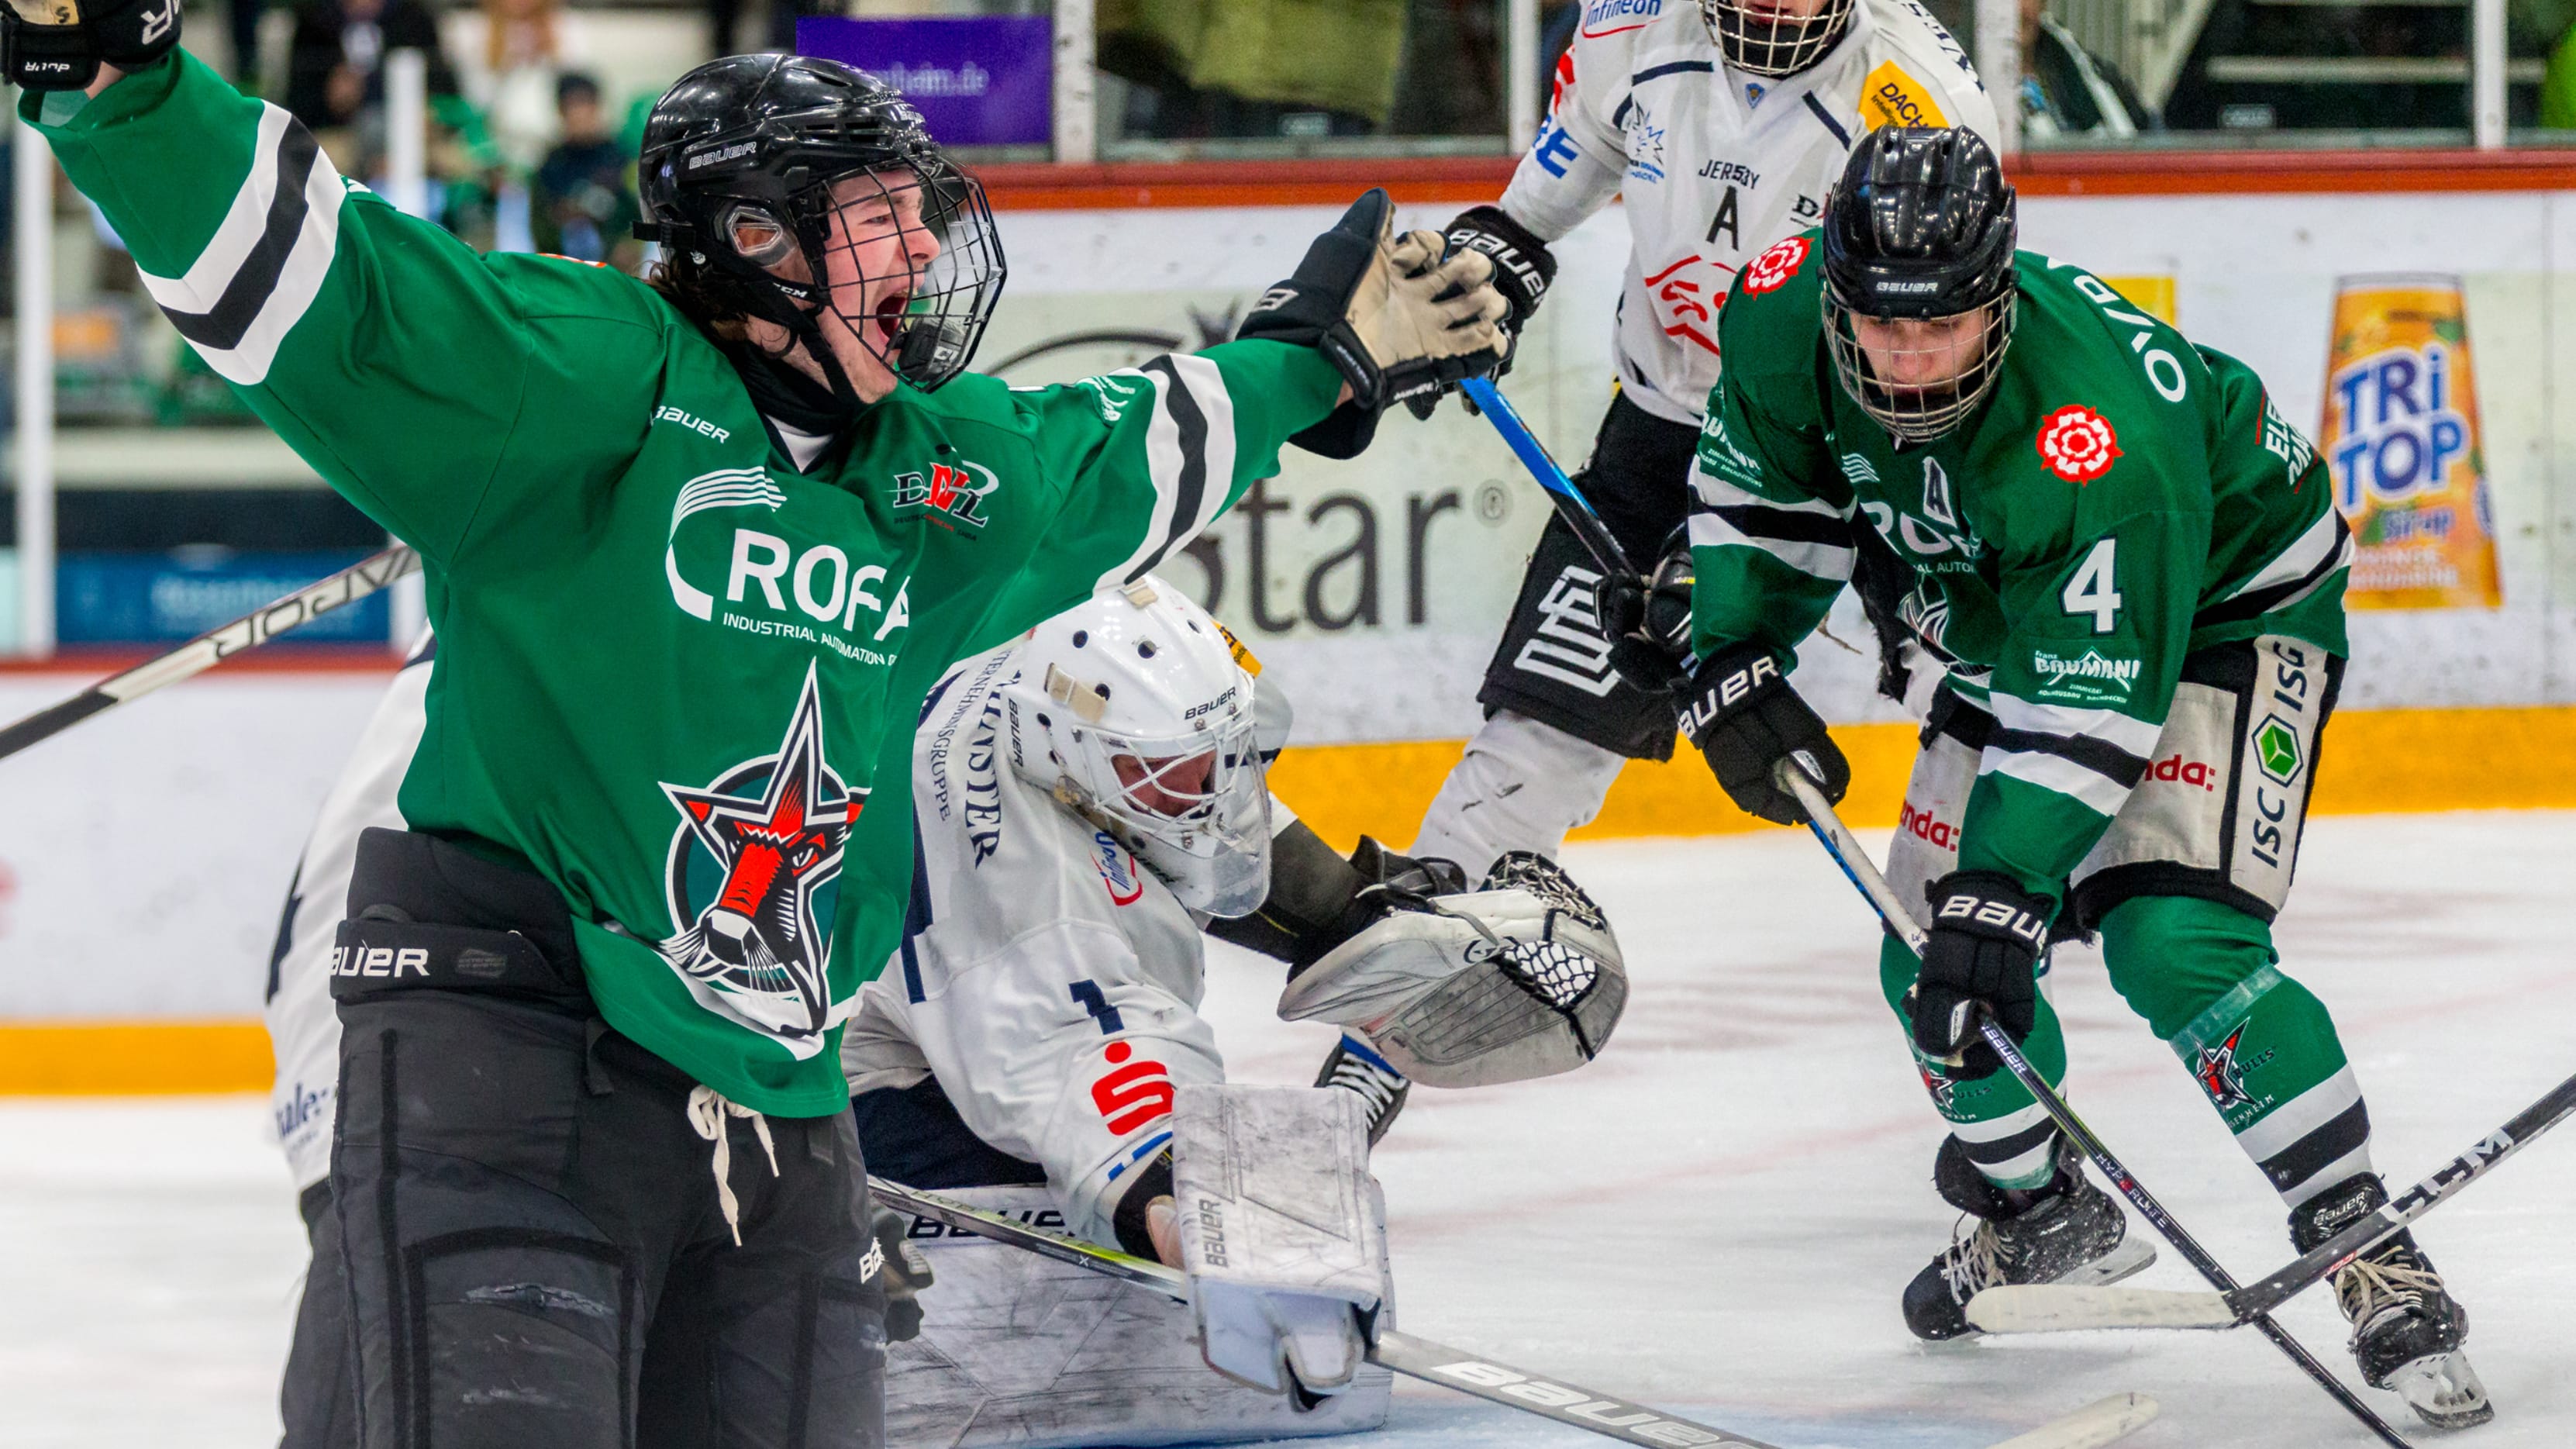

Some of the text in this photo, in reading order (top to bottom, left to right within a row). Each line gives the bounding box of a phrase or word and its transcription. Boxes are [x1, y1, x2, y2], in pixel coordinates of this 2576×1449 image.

[688, 141, 757, 171] BAUER
[1705, 184, 1740, 252] A
[772, 281, 808, 298] CM
[1450, 228, 1546, 305] BAUE
[653, 403, 731, 444] BAUER
[1923, 457, 1957, 526] A
[2336, 420, 2462, 507] TOP
[726, 528, 910, 642] ROFA
[1184, 479, 1464, 634] tar
[2061, 536, 2123, 635] 4
[722, 612, 817, 643] INDUSTRIAL
[821, 633, 885, 667] AUTOMATION
[1184, 688, 1237, 720] BAUER
[1678, 655, 1780, 739] AUER
[1007, 697, 1024, 768] BAUER
[2144, 754, 2216, 793] nda:
[2251, 785, 2286, 869] ISC
[1939, 895, 2047, 952] BAU
[329, 946, 432, 978] AUER
[1068, 978, 1125, 1035] 1
[2232, 1049, 2276, 1079] BULLS
[1198, 1198, 1229, 1269] BAUER
